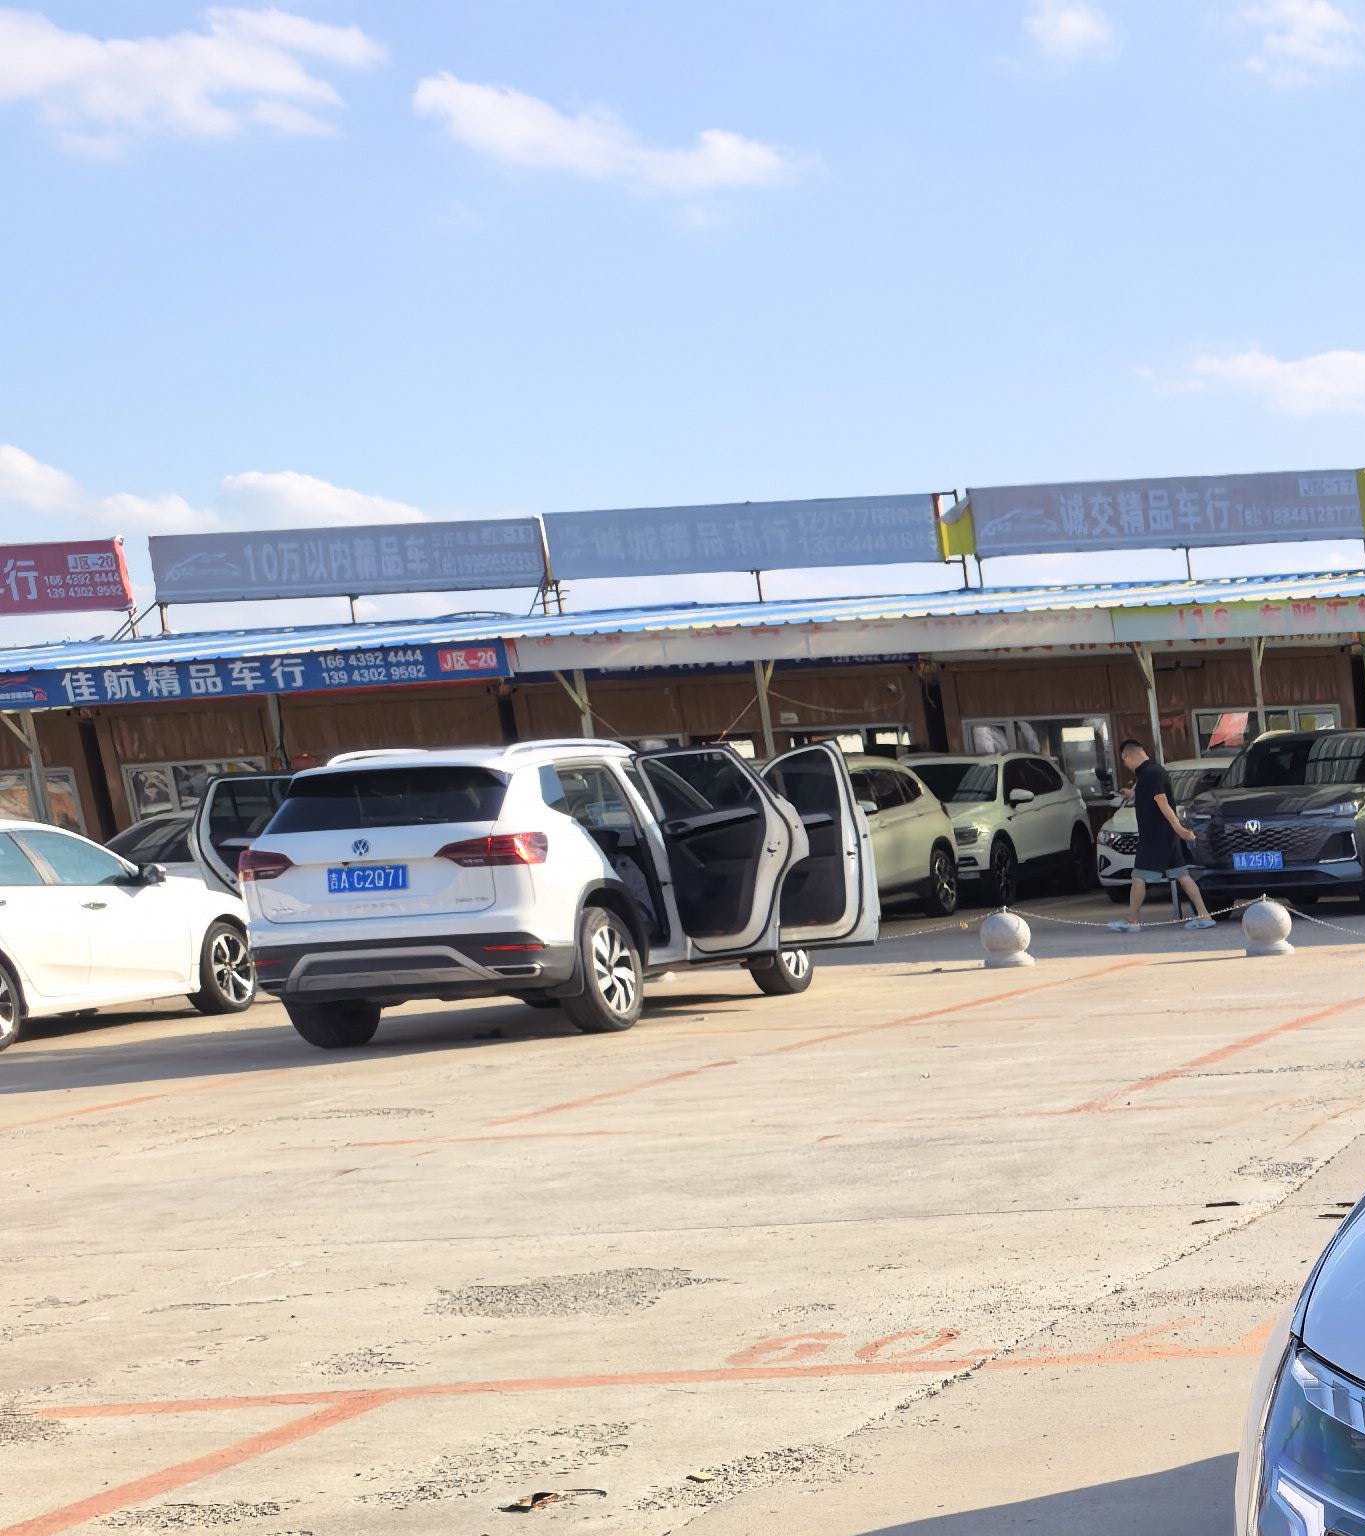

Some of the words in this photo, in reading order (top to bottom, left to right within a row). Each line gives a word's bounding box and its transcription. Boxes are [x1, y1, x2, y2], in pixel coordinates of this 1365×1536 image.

[387, 649, 423, 664] 4444
[442, 651, 498, 670] J区-20
[62, 657, 305, 702] 佳航精品车行
[322, 671, 348, 686] 139
